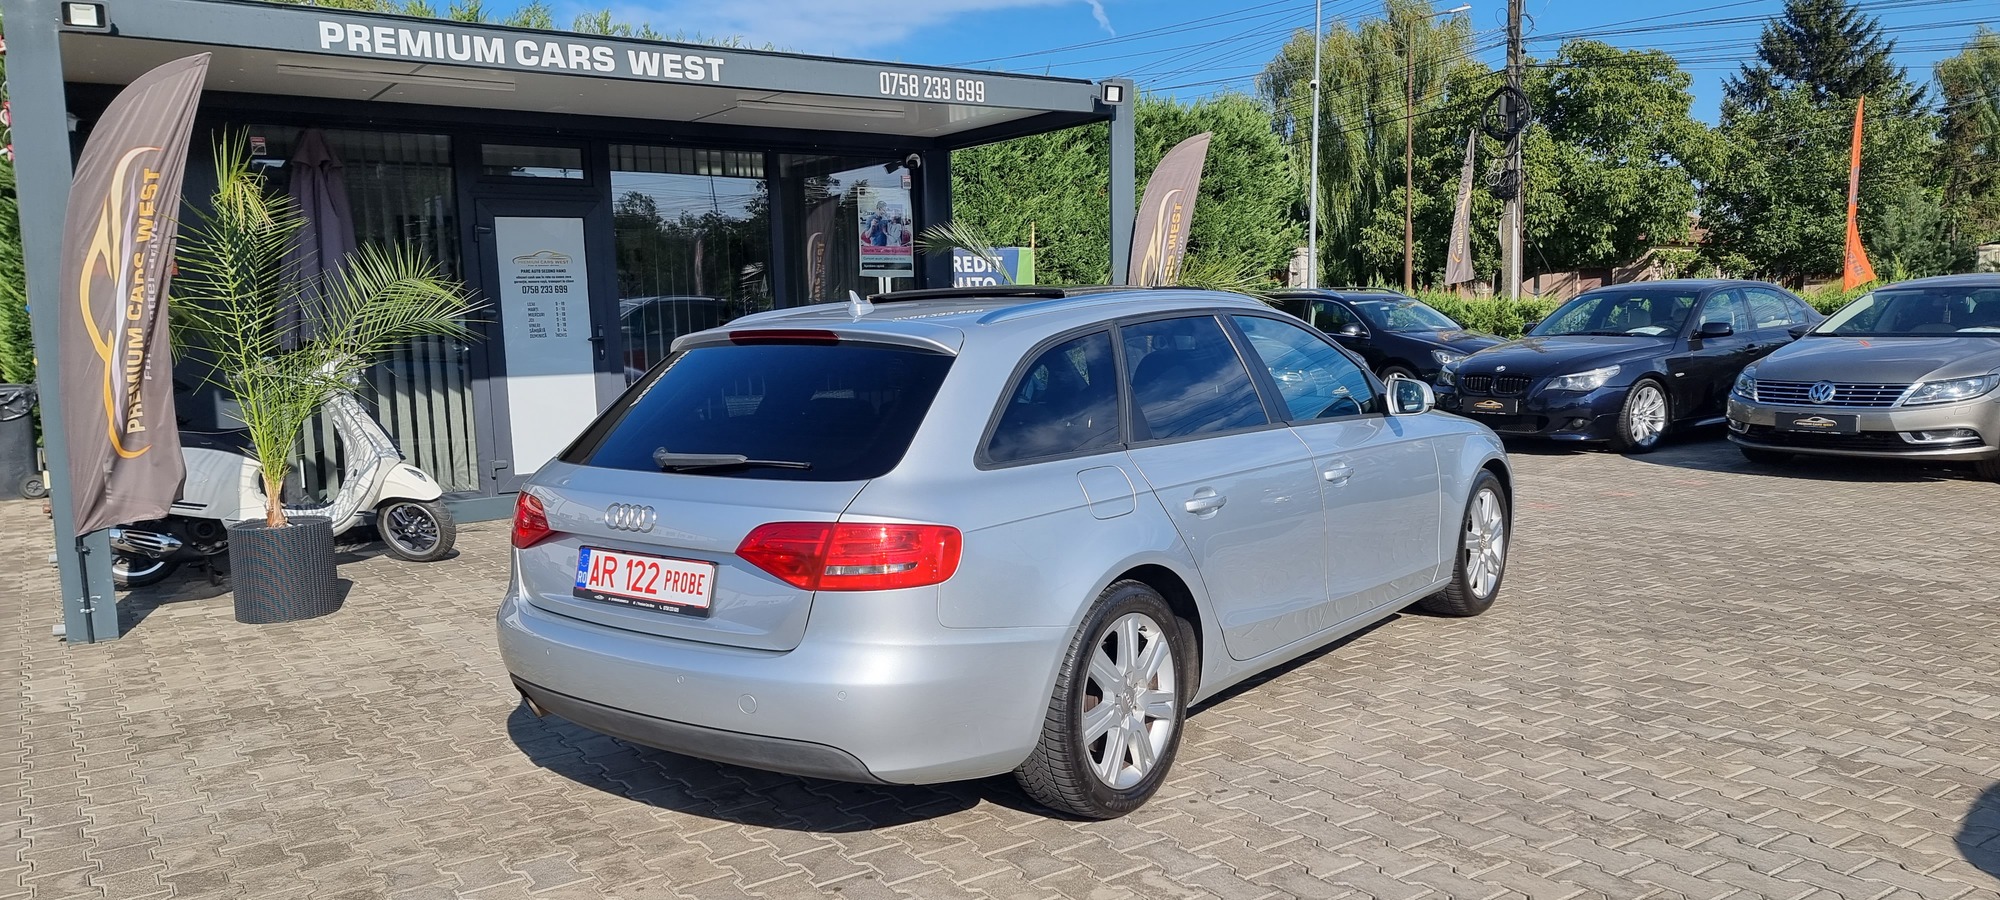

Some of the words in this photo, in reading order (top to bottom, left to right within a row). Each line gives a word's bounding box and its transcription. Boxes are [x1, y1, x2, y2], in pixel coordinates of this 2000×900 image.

[318, 20, 506, 65] PREMIUM
[514, 39, 617, 72] CARS
[626, 50, 725, 82] WEST
[879, 71, 920, 97] 0758
[922, 75, 952, 100] 233
[955, 79, 985, 103] 699
[1168, 202, 1183, 251] WEST
[126, 327, 146, 434] PREMIUM
[136, 167, 161, 243] WEST
[522, 285, 540, 294] 0758
[540, 285, 553, 294] 233
[554, 285, 568, 294] 699
[576, 570, 588, 584] RO
[588, 554, 619, 588] AR
[625, 558, 661, 595] 122
[663, 569, 706, 596] PROBE
